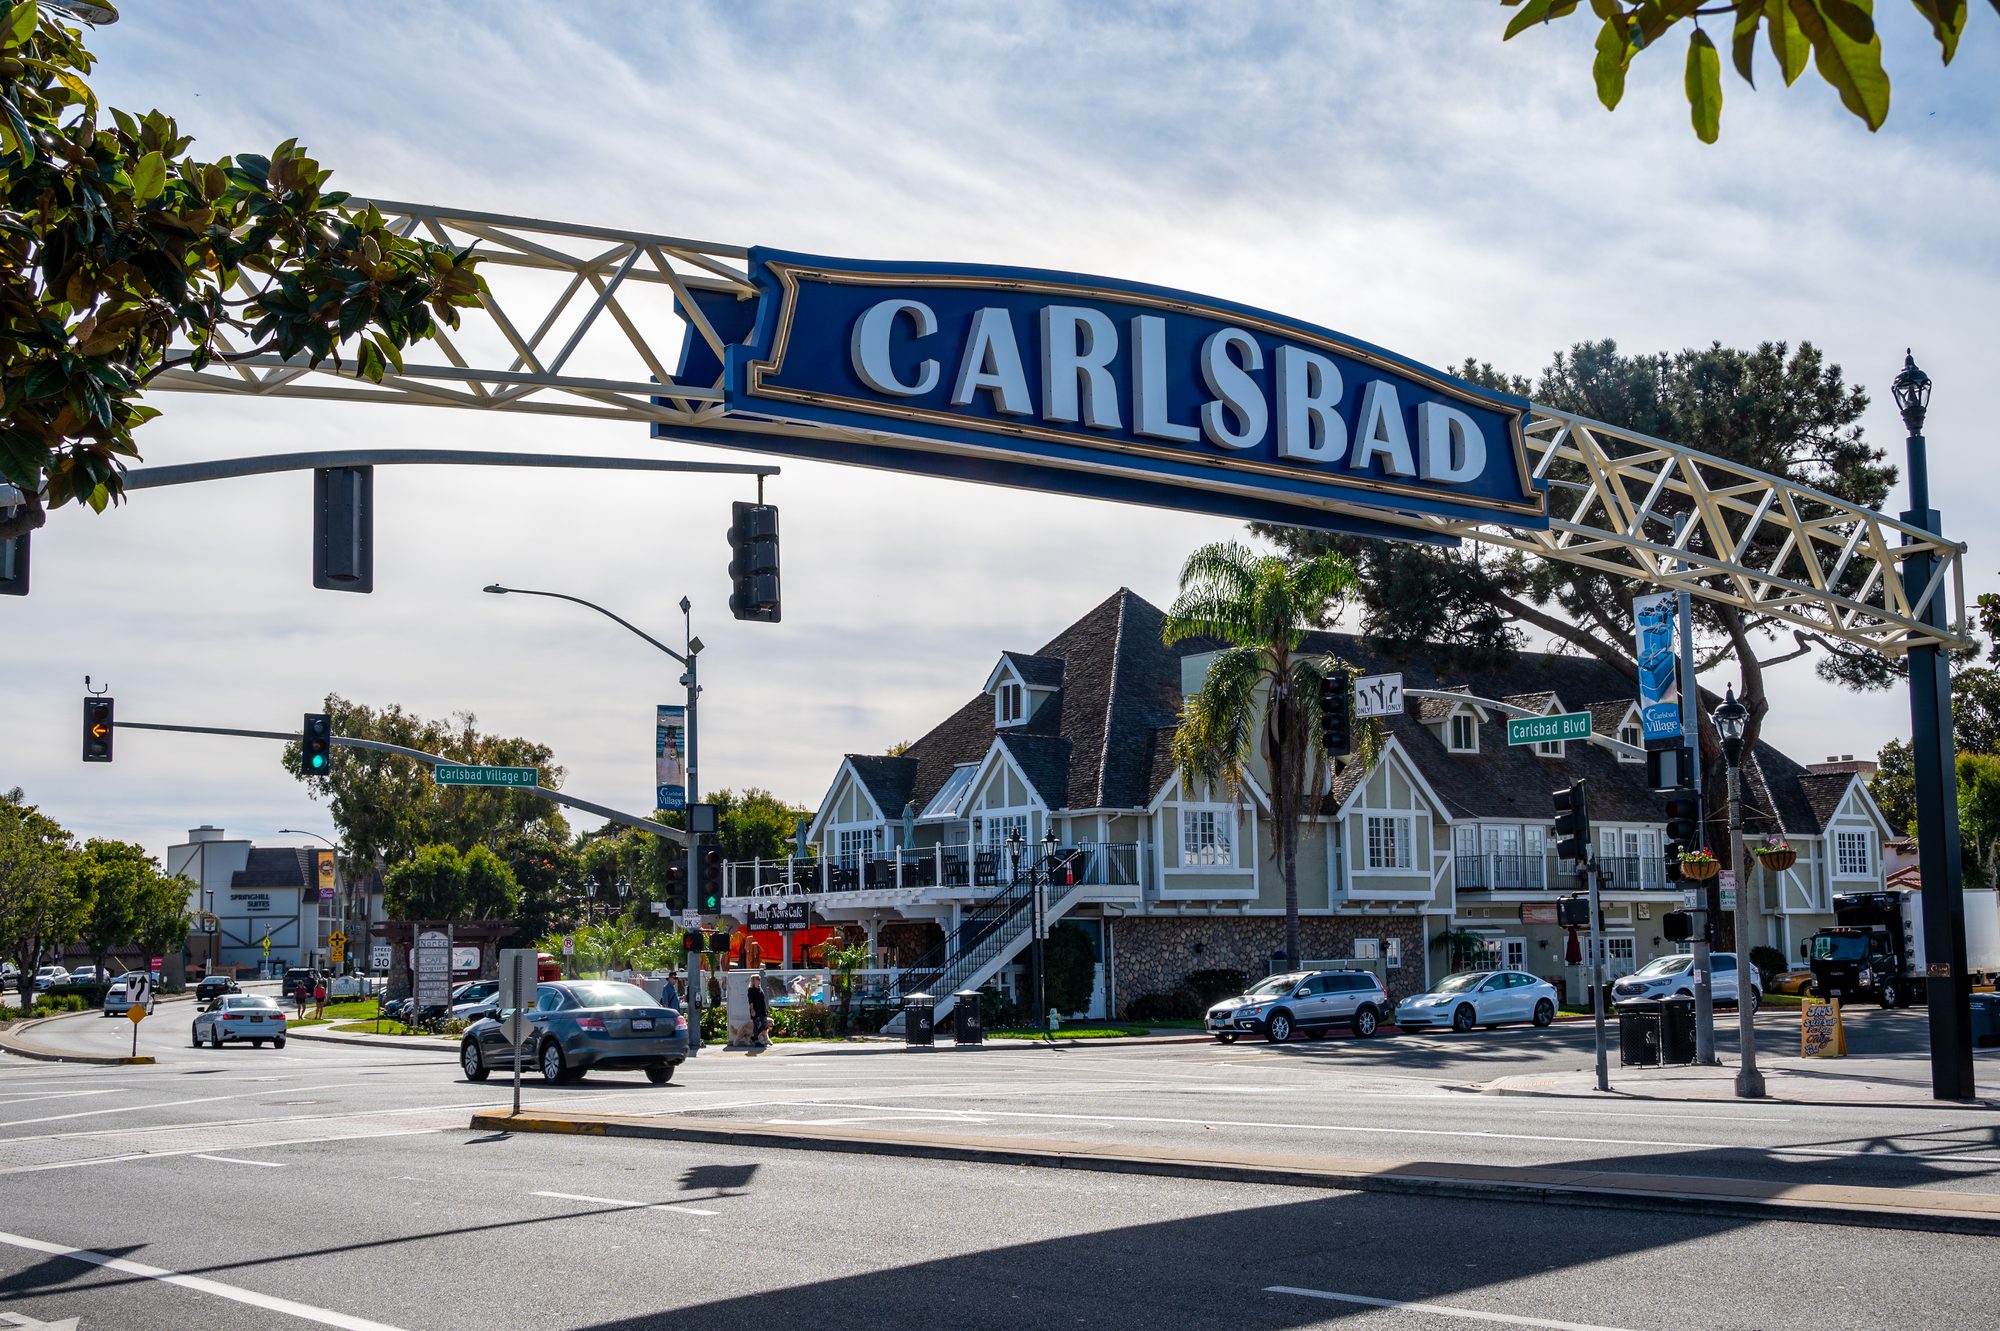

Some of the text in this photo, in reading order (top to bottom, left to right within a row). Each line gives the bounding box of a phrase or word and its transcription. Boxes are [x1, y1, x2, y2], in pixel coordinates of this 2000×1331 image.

[850, 298, 1487, 484] CARLSBAD
[1357, 707, 1371, 715] ONLY
[1388, 703, 1402, 711] ONLY
[1653, 710, 1677, 719] Carlsbad
[1513, 718, 1586, 738] Carlsbad Blvd
[1646, 720, 1678, 733] Village
[440, 768, 533, 784] Carlsbad Village Dr
[659, 796, 684, 808] Village
[771, 907, 789, 919] News
[788, 906, 803, 918] Café
[333, 950, 343, 958] 25
[374, 959, 390, 968] 30
[1806, 1006, 1834, 1017] JAYS
